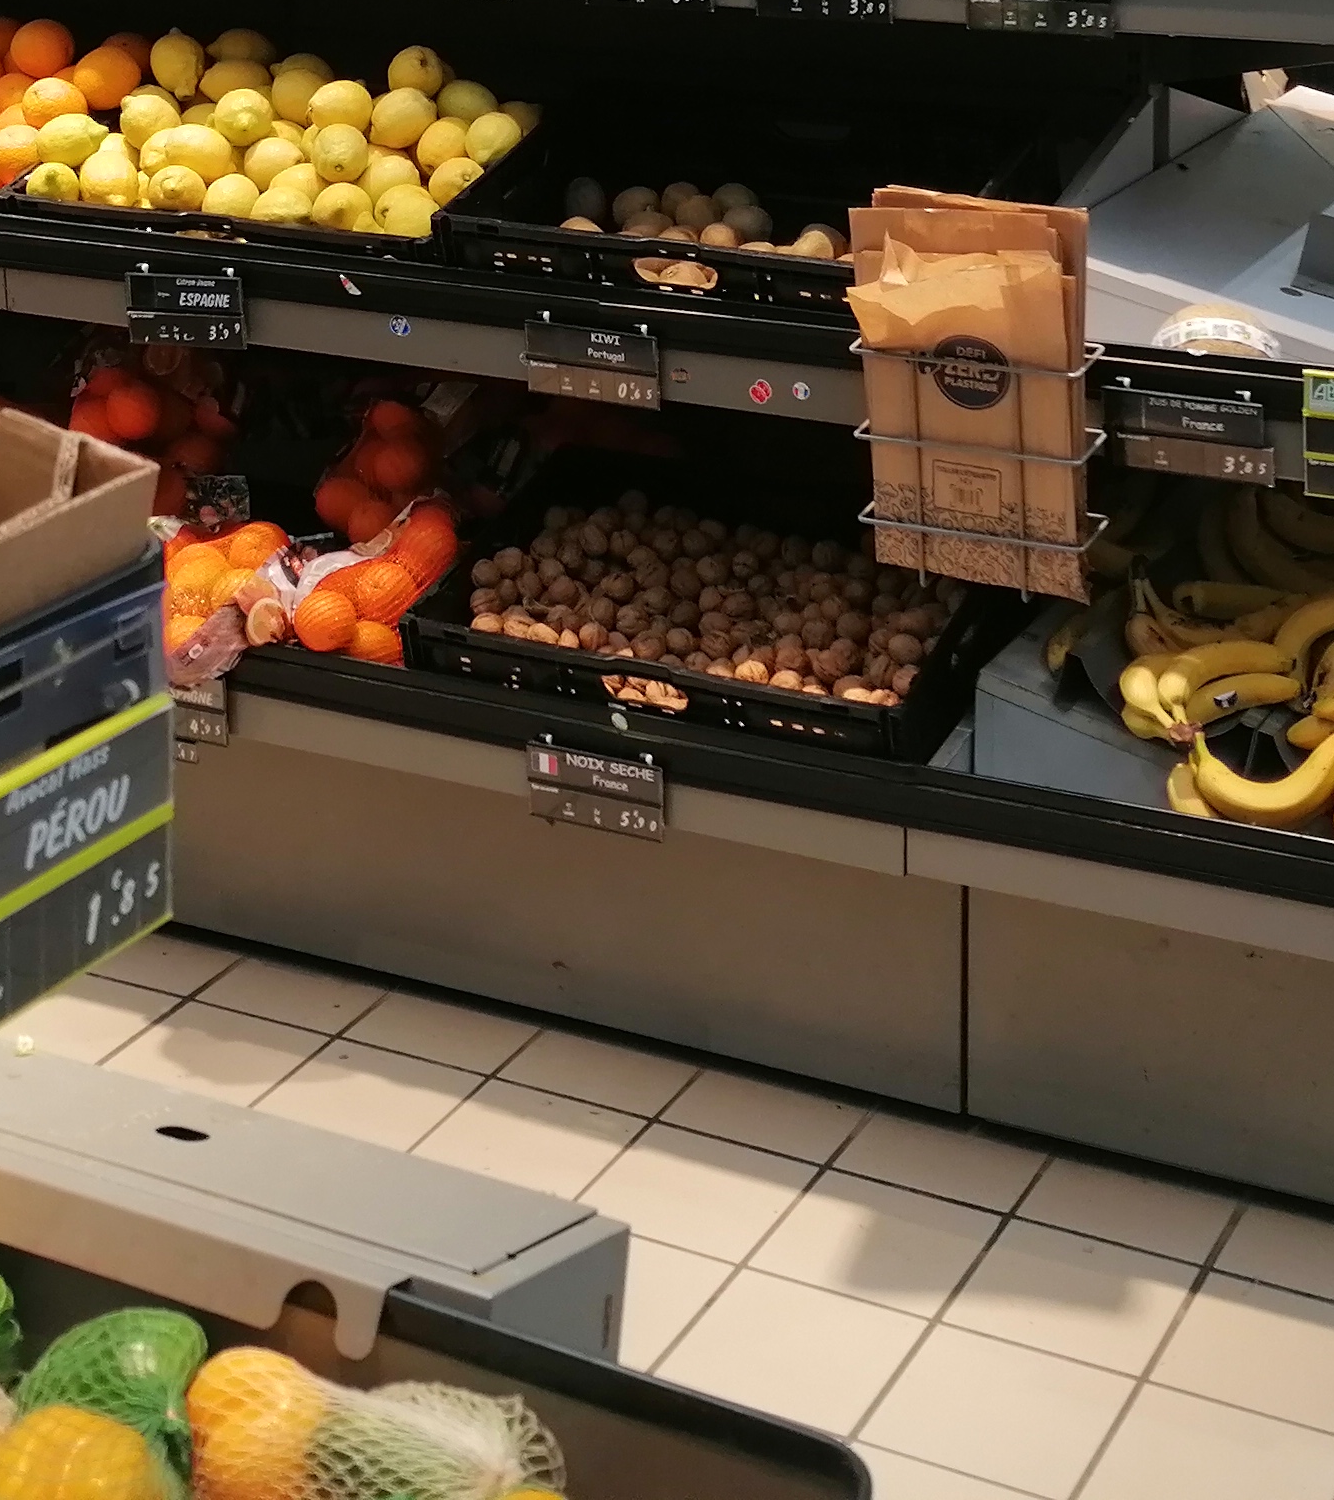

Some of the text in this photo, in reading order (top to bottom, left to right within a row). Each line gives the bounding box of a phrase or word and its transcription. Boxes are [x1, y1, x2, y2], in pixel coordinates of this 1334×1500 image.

[178, 292, 230, 308] ESPAGNE
[590, 332, 621, 346] KIWI
[587, 347, 626, 363] Portugal
[1180, 415, 1225, 432] France
[565, 753, 655, 783] NOIX SECHE
[592, 774, 629, 793] France
[24, 775, 131, 871] PÉROU
